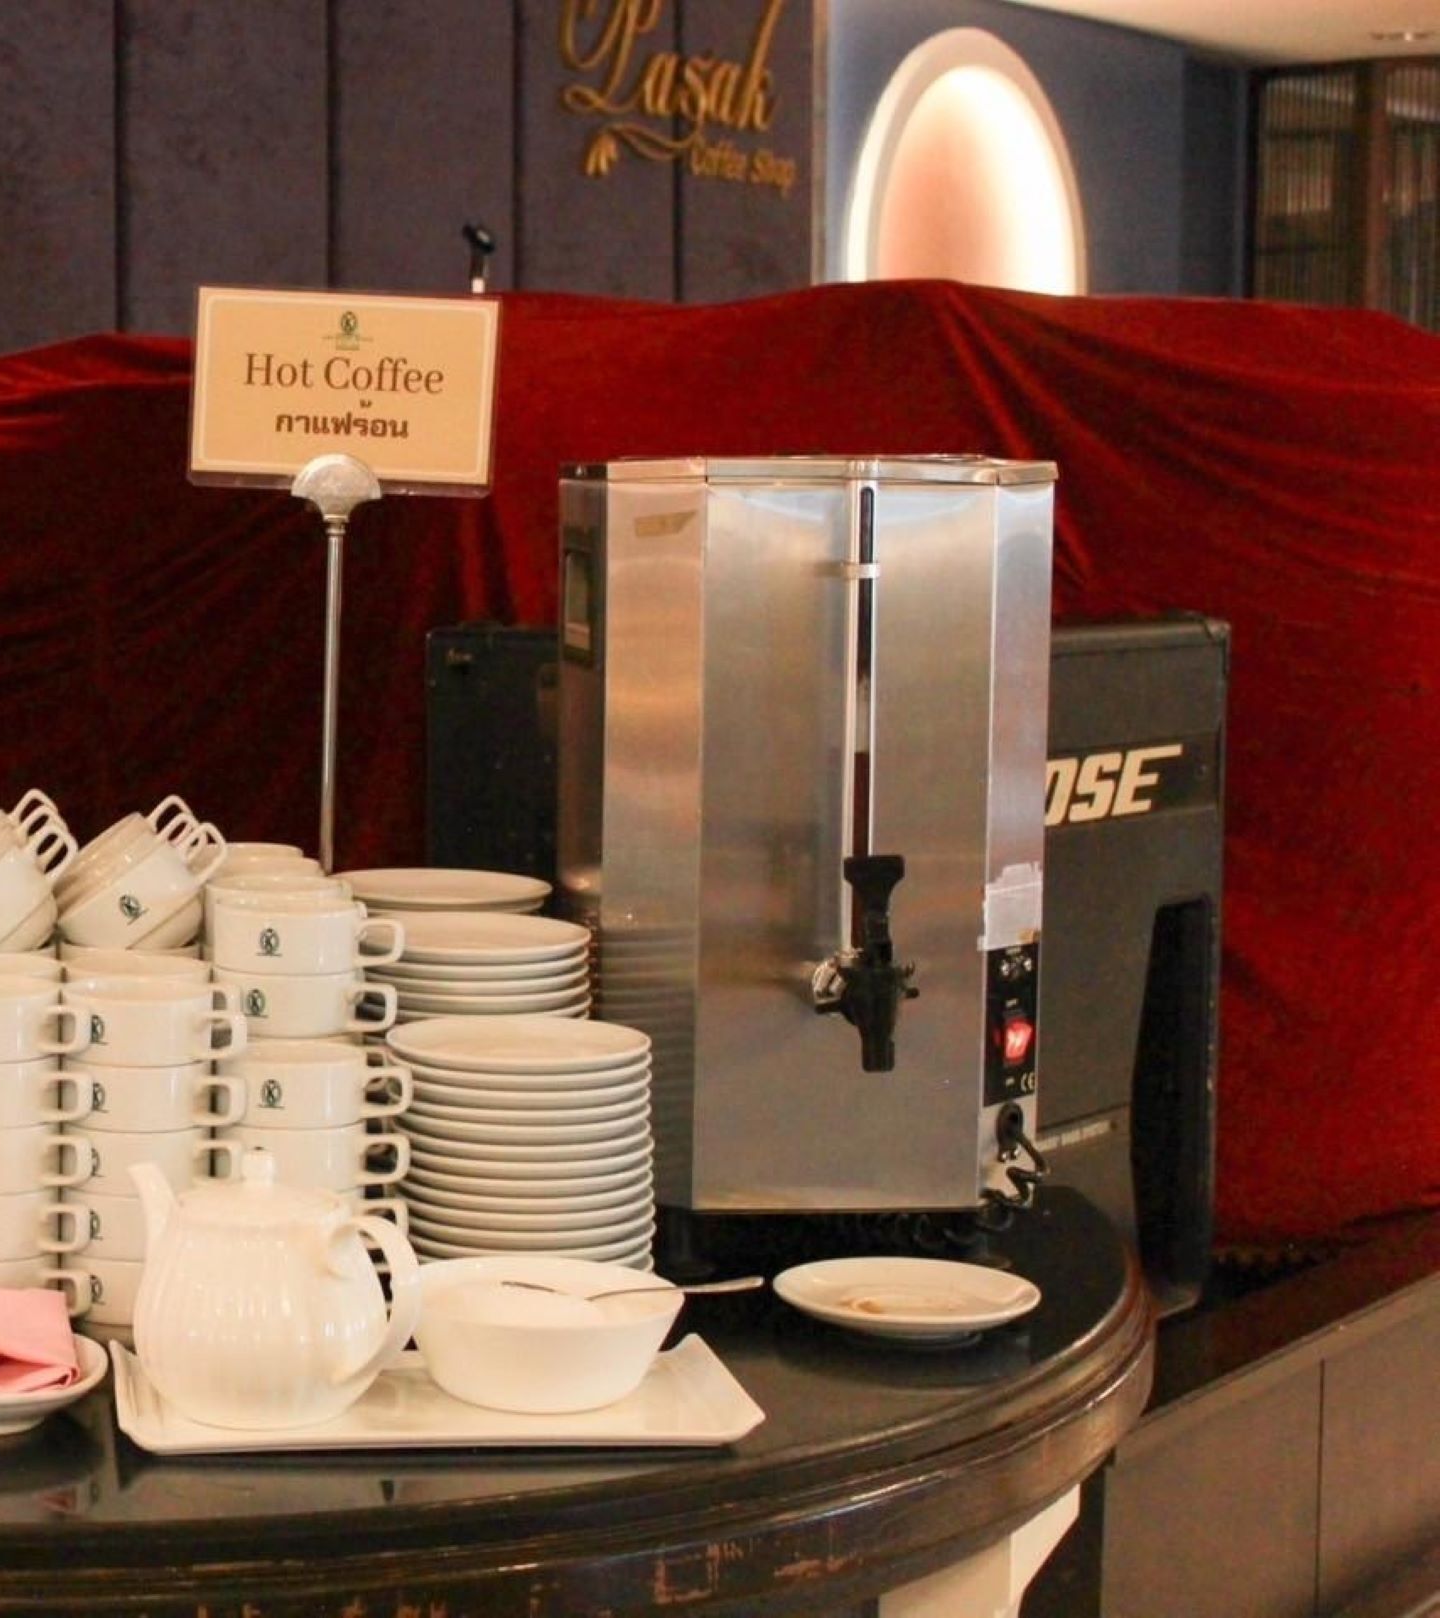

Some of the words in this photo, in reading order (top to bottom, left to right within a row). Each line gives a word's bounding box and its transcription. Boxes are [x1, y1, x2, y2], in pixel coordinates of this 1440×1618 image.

[243, 352, 315, 388] Hot
[323, 355, 445, 395] Coffee
[274, 398, 409, 439] กาแฟร้อน
[1044, 743, 1183, 826] OSE
